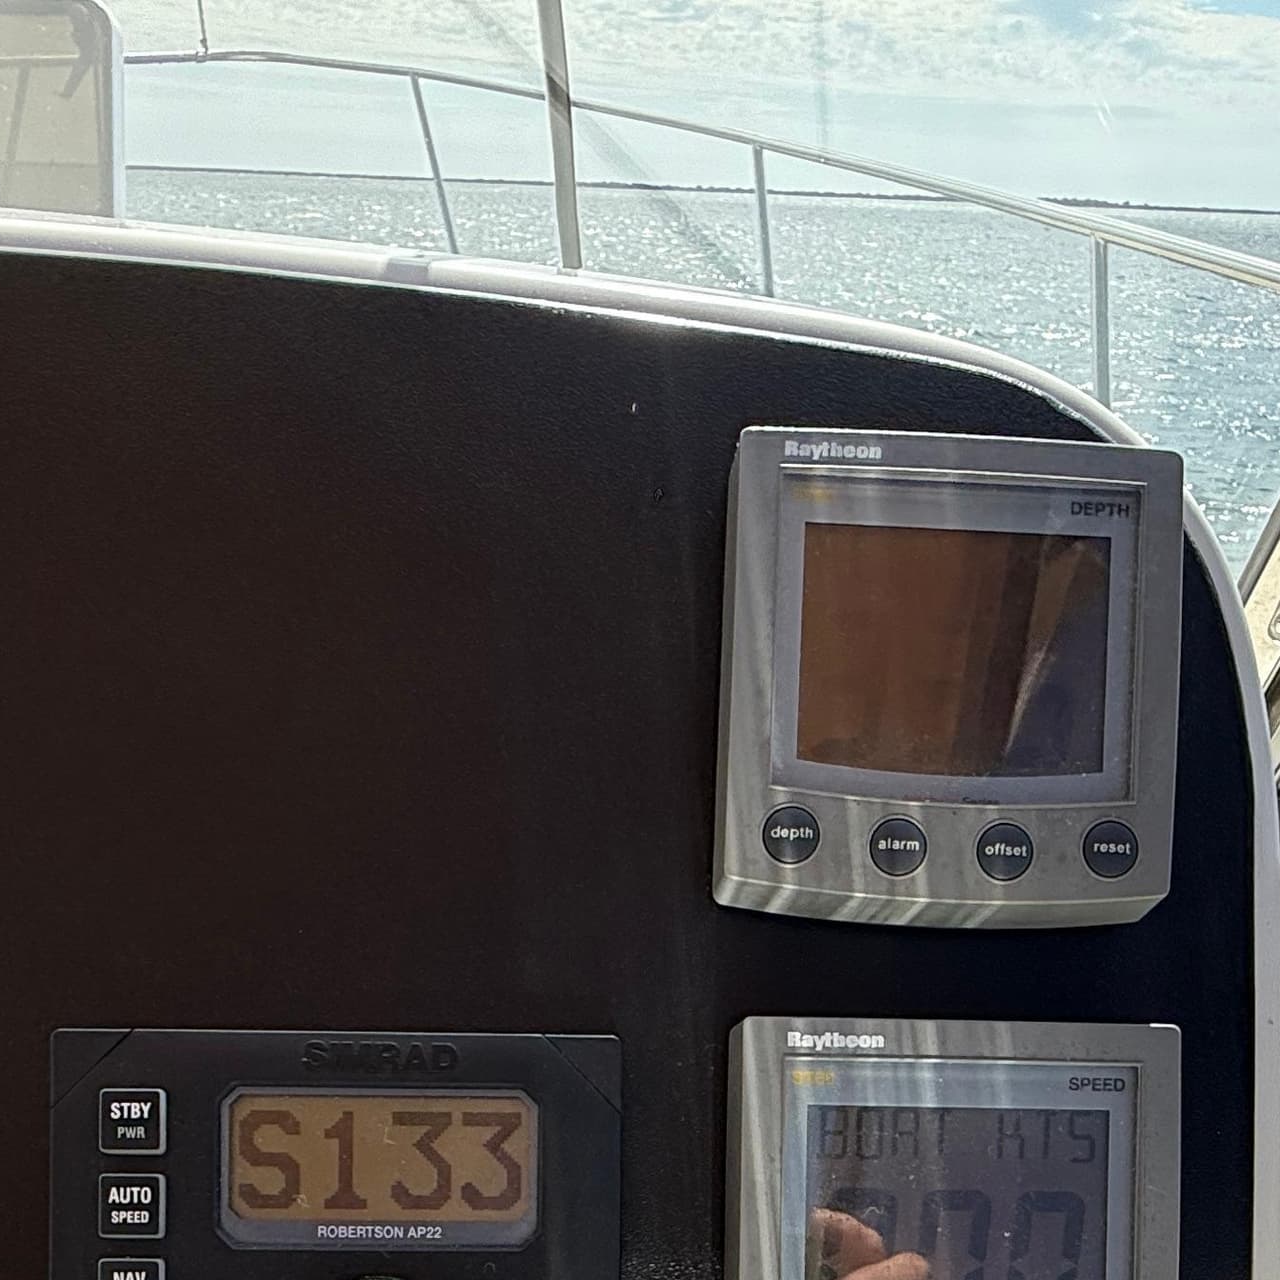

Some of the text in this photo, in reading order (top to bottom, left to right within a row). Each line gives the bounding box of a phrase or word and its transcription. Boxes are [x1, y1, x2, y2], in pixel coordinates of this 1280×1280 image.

[784, 440, 882, 461] Raytheon
[1070, 501, 1130, 518] DEPTH
[770, 825, 814, 842] depth
[877, 836, 920, 851] alarm
[984, 842, 1028, 857] offset
[1093, 840, 1131, 855] reset
[787, 1031, 885, 1051] Raytheon
[1068, 1076, 1126, 1093] SPEED
[109, 1101, 151, 1120] STBY
[117, 1125, 146, 1140] PWR
[996, 1107, 1098, 1164] KTS
[108, 1187, 152, 1205] AUTO
[111, 1210, 150, 1224] SPEED
[317, 1225, 443, 1240] ROBERTSON AP22
